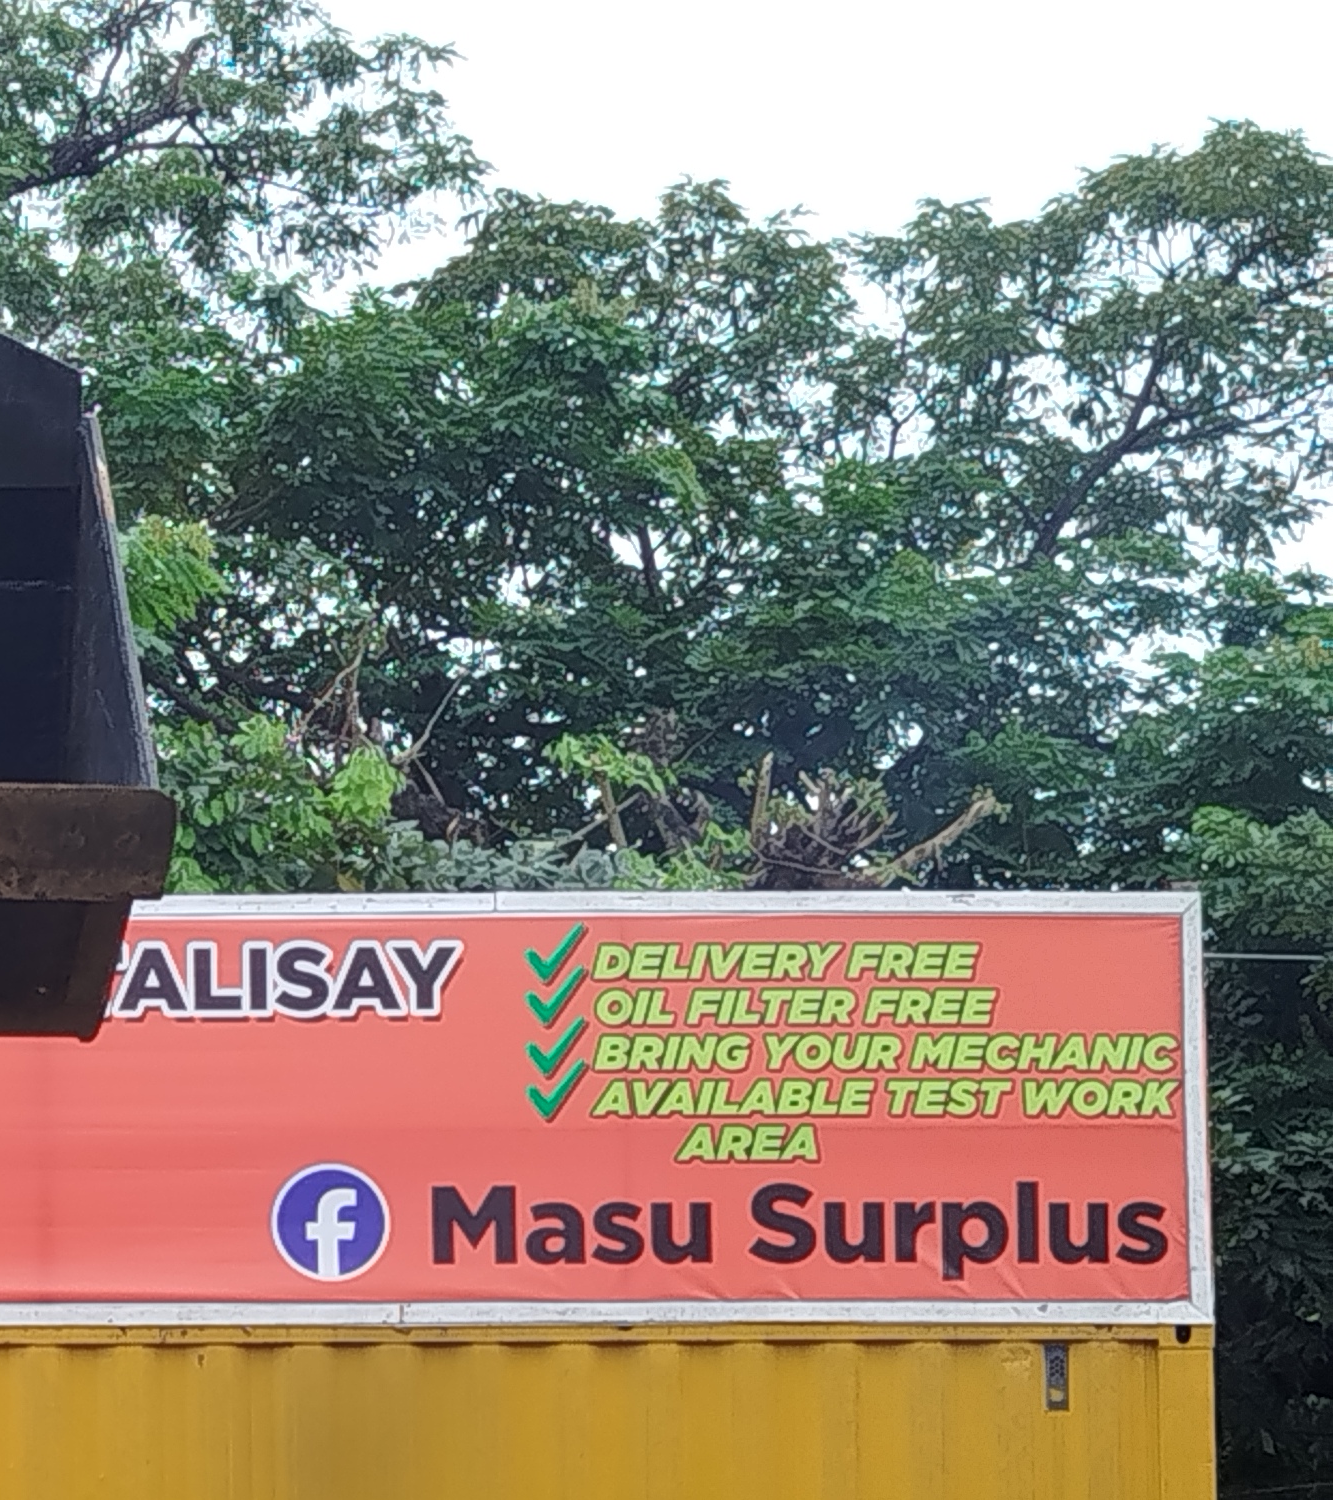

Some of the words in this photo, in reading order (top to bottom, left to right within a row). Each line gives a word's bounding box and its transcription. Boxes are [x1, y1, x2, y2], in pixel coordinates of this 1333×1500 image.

[107, 943, 461, 1014] ALISAY
[593, 943, 840, 980] DELIVERY
[846, 943, 980, 980] FREE
[593, 988, 674, 1025] OIL
[685, 988, 855, 1025] FILTER
[865, 988, 997, 1025] FREE
[593, 1033, 748, 1071] BRING
[765, 1033, 899, 1071] YOUR
[910, 1033, 1177, 1071] MECHANIC
[591, 1079, 871, 1116] AVAILABLE
[885, 1079, 1013, 1116] TEST
[1023, 1079, 1179, 1117] WORK
[674, 1123, 819, 1162] AREA
[431, 1185, 712, 1266] Masu
[747, 1182, 1169, 1281] Surplus
